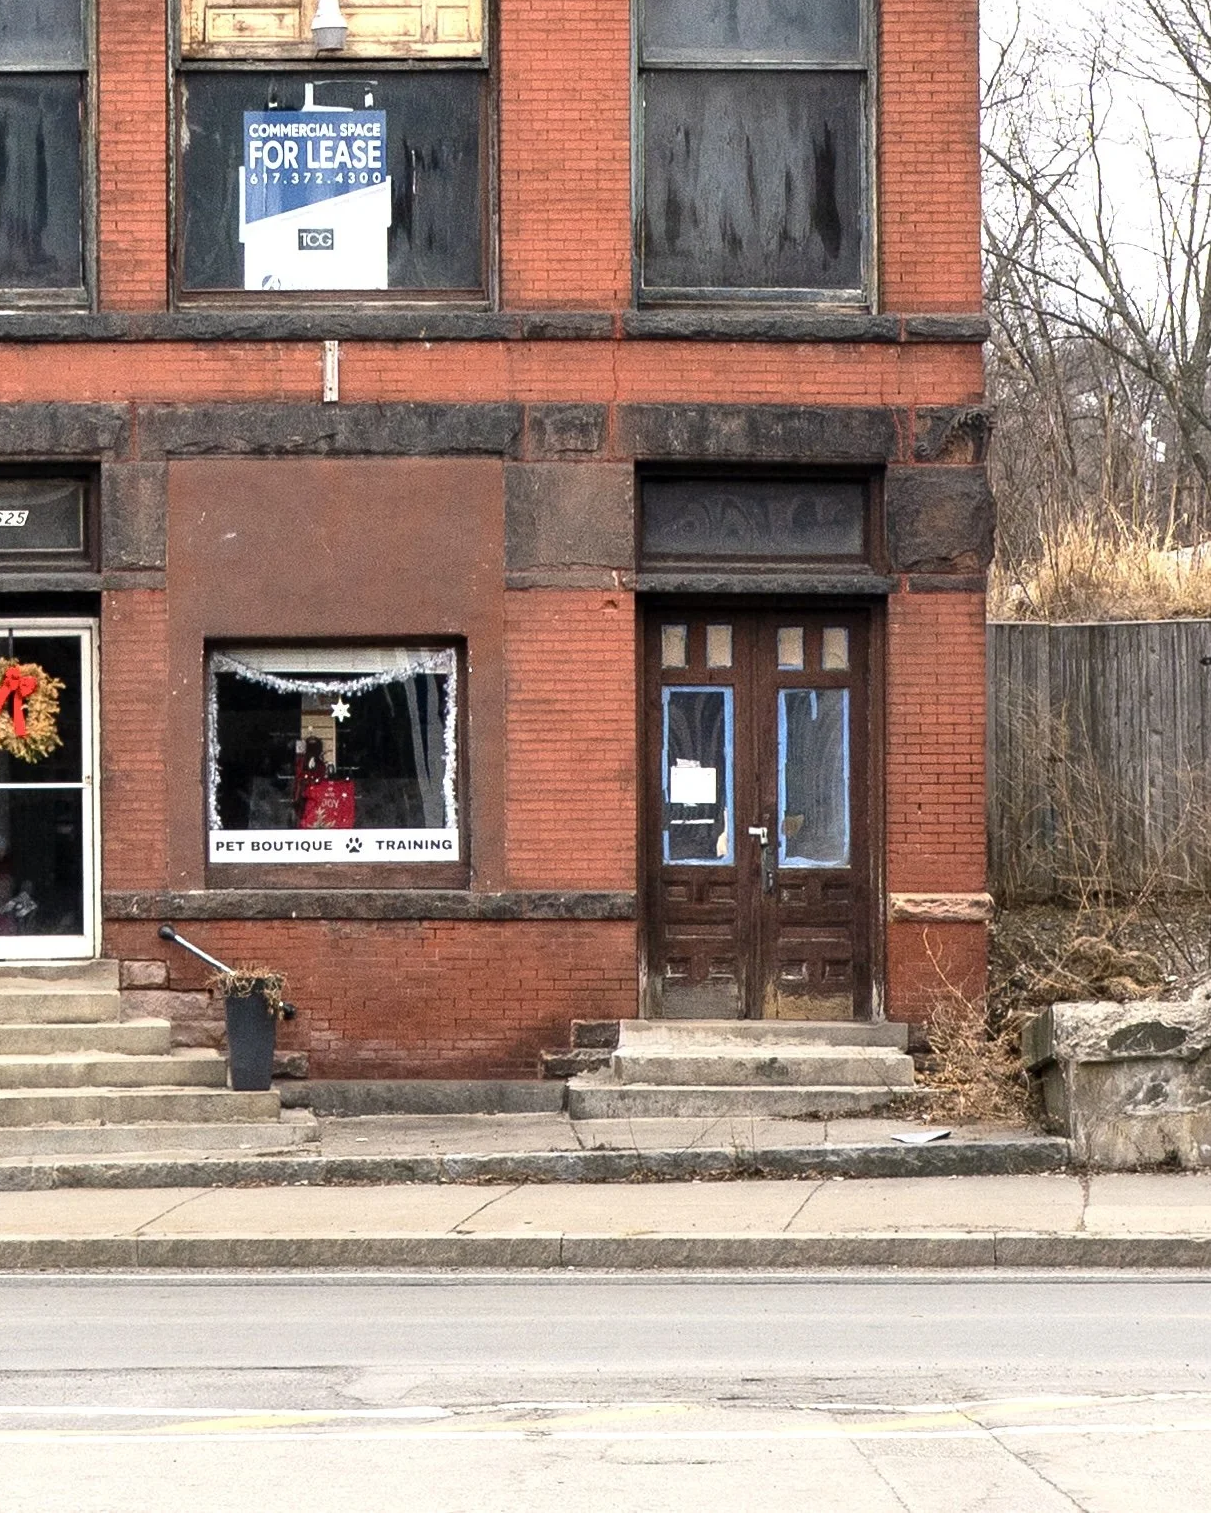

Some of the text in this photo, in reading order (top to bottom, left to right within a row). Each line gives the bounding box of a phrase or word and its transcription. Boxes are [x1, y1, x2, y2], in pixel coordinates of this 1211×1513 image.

[249, 123, 381, 138] COMMERCIAL SPACE
[249, 140, 382, 170] FOR LEASE
[249, 172, 382, 185] 617.372.4300
[300, 232, 333, 247] TCG
[215, 839, 453, 853] PET BOUTIQUE TRAINING
